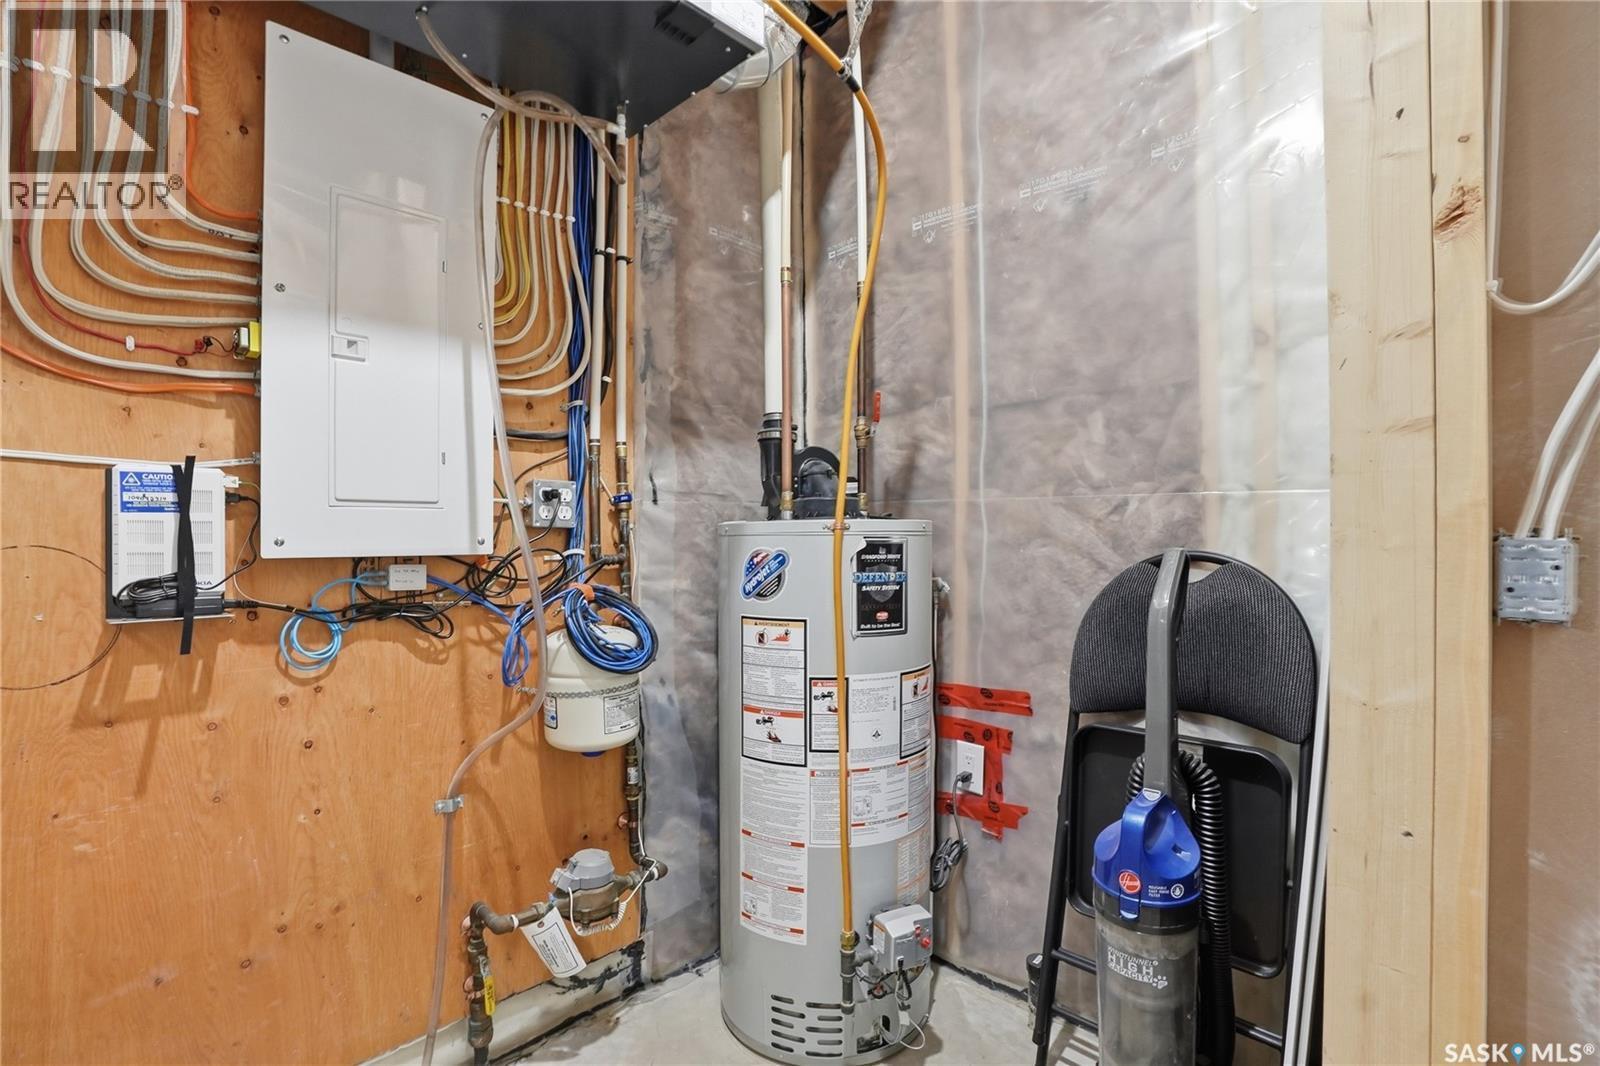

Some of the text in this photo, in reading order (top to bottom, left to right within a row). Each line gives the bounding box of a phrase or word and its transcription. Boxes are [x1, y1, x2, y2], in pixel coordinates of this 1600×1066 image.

[142, 473, 173, 481] CAUTIO
[853, 572, 907, 583] DEFENDER
[1108, 951, 1154, 976] HIGH
